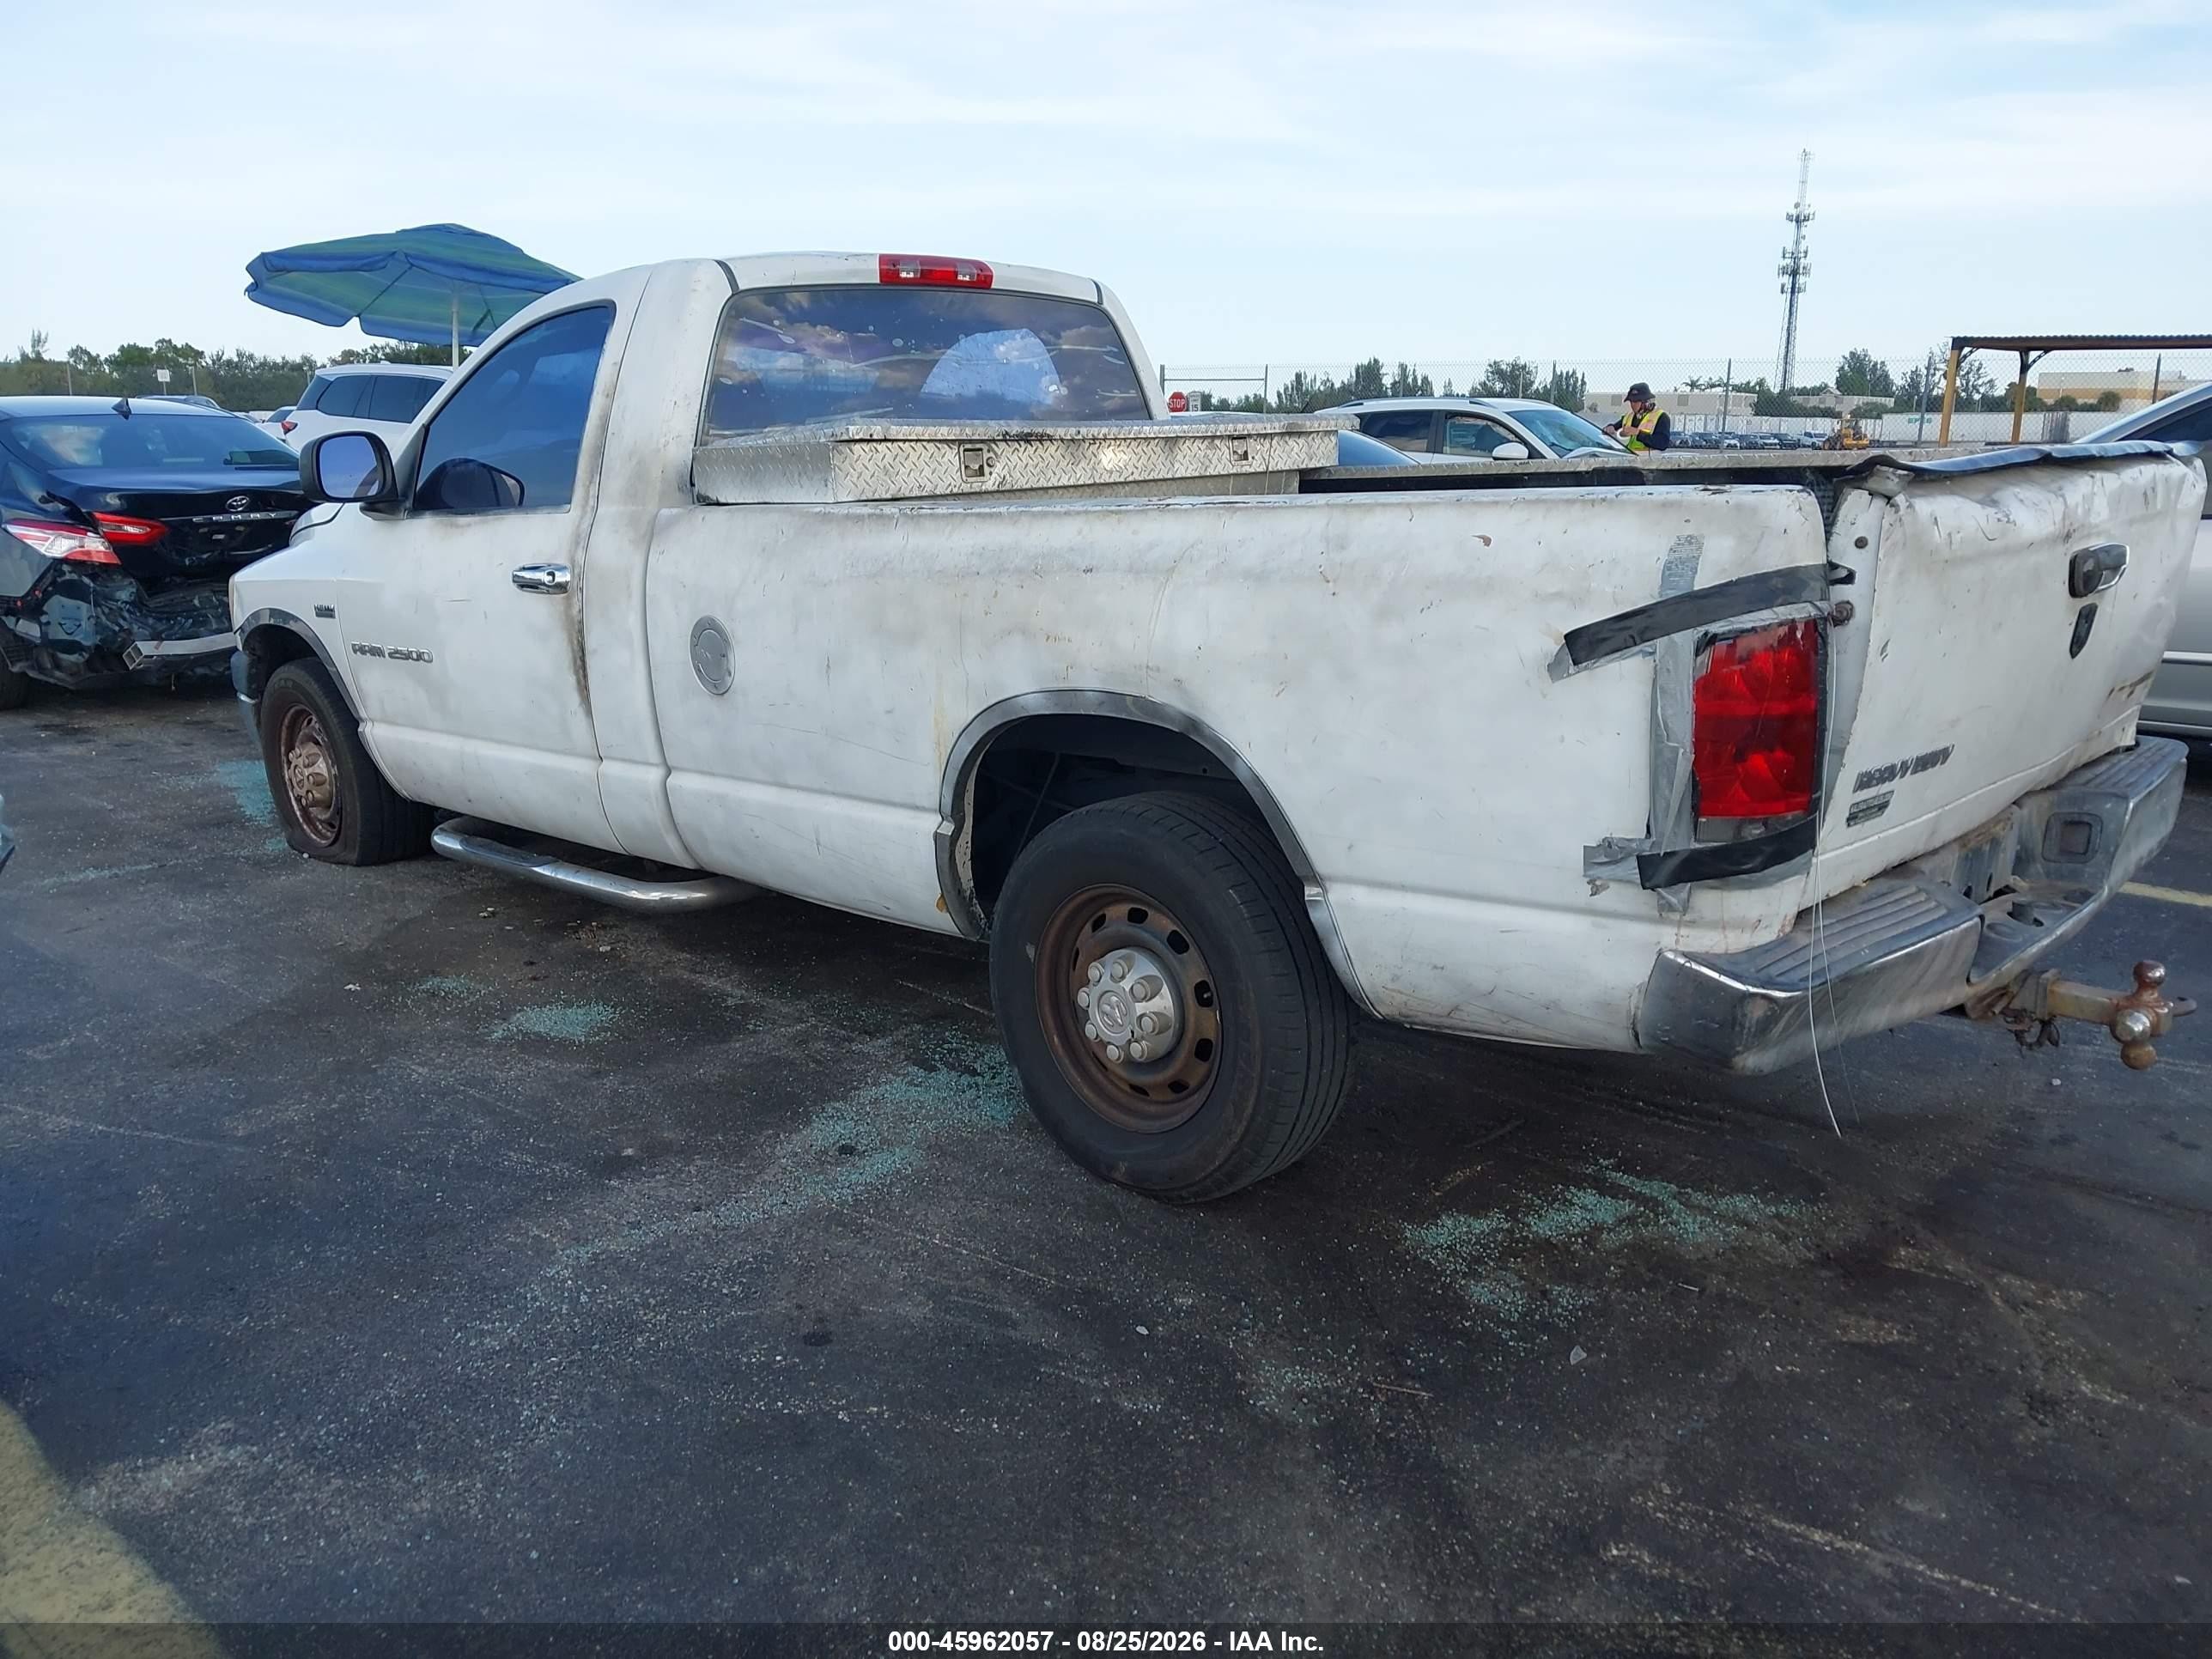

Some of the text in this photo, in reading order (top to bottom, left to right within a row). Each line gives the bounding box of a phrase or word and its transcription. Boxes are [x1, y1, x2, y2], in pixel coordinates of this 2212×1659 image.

[1169, 398, 1185, 408] STOP
[192, 513, 276, 523] CAMRY
[351, 641, 434, 663] RAM 2500
